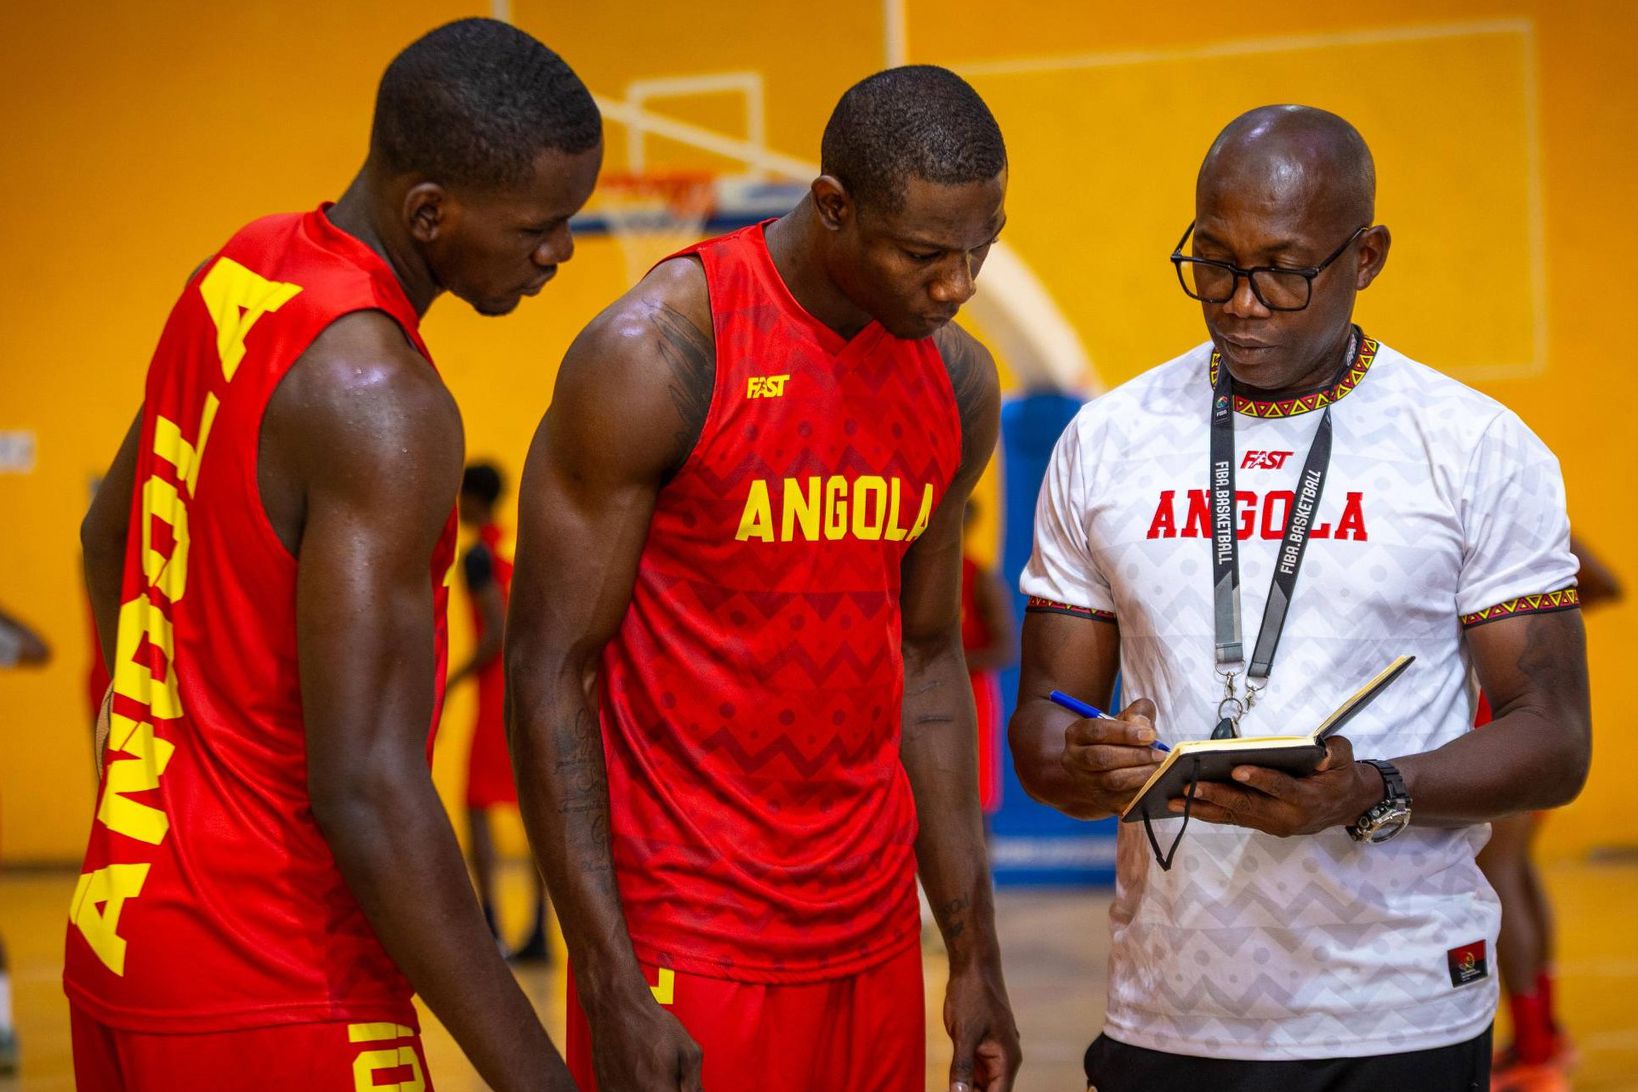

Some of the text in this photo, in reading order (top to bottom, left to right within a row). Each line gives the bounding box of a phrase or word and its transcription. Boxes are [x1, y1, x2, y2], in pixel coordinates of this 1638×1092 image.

[746, 375, 790, 399] FAST
[1240, 450, 1294, 470] FAST
[1216, 461, 1233, 565] FIBA.BASKETBALL
[1280, 469, 1321, 575] FIBA.BASKETBALL
